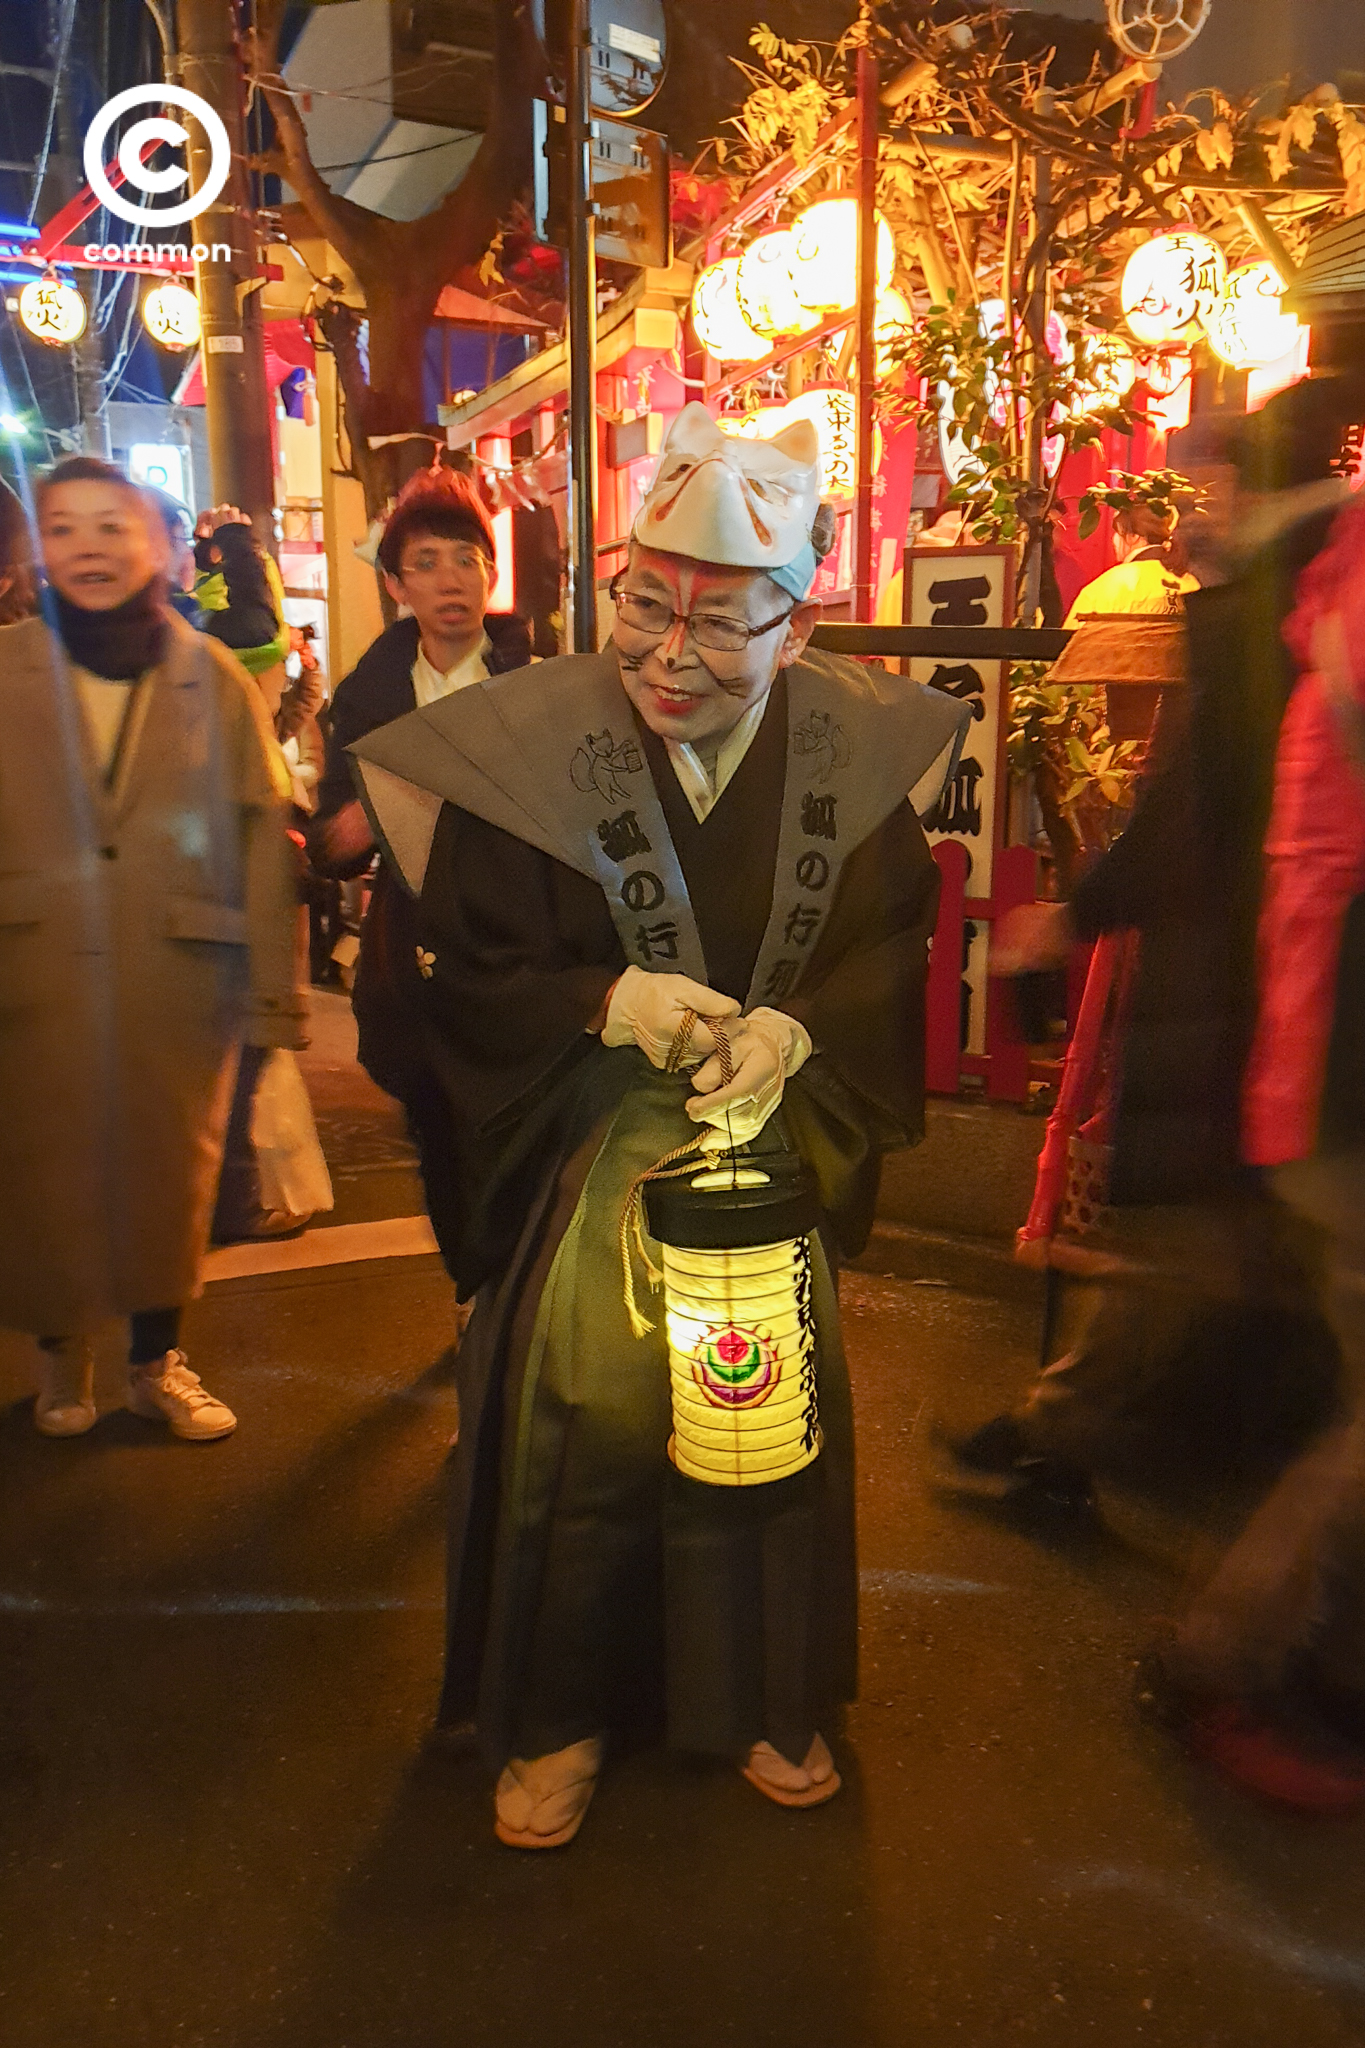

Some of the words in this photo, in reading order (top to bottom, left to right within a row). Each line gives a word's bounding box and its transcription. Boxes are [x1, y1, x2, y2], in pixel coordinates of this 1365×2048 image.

[35, 289, 63, 331] 狐火
[157, 300, 183, 335] 火
[1171, 255, 1220, 331] 狐火
[597, 810, 684, 972] 狐の行
